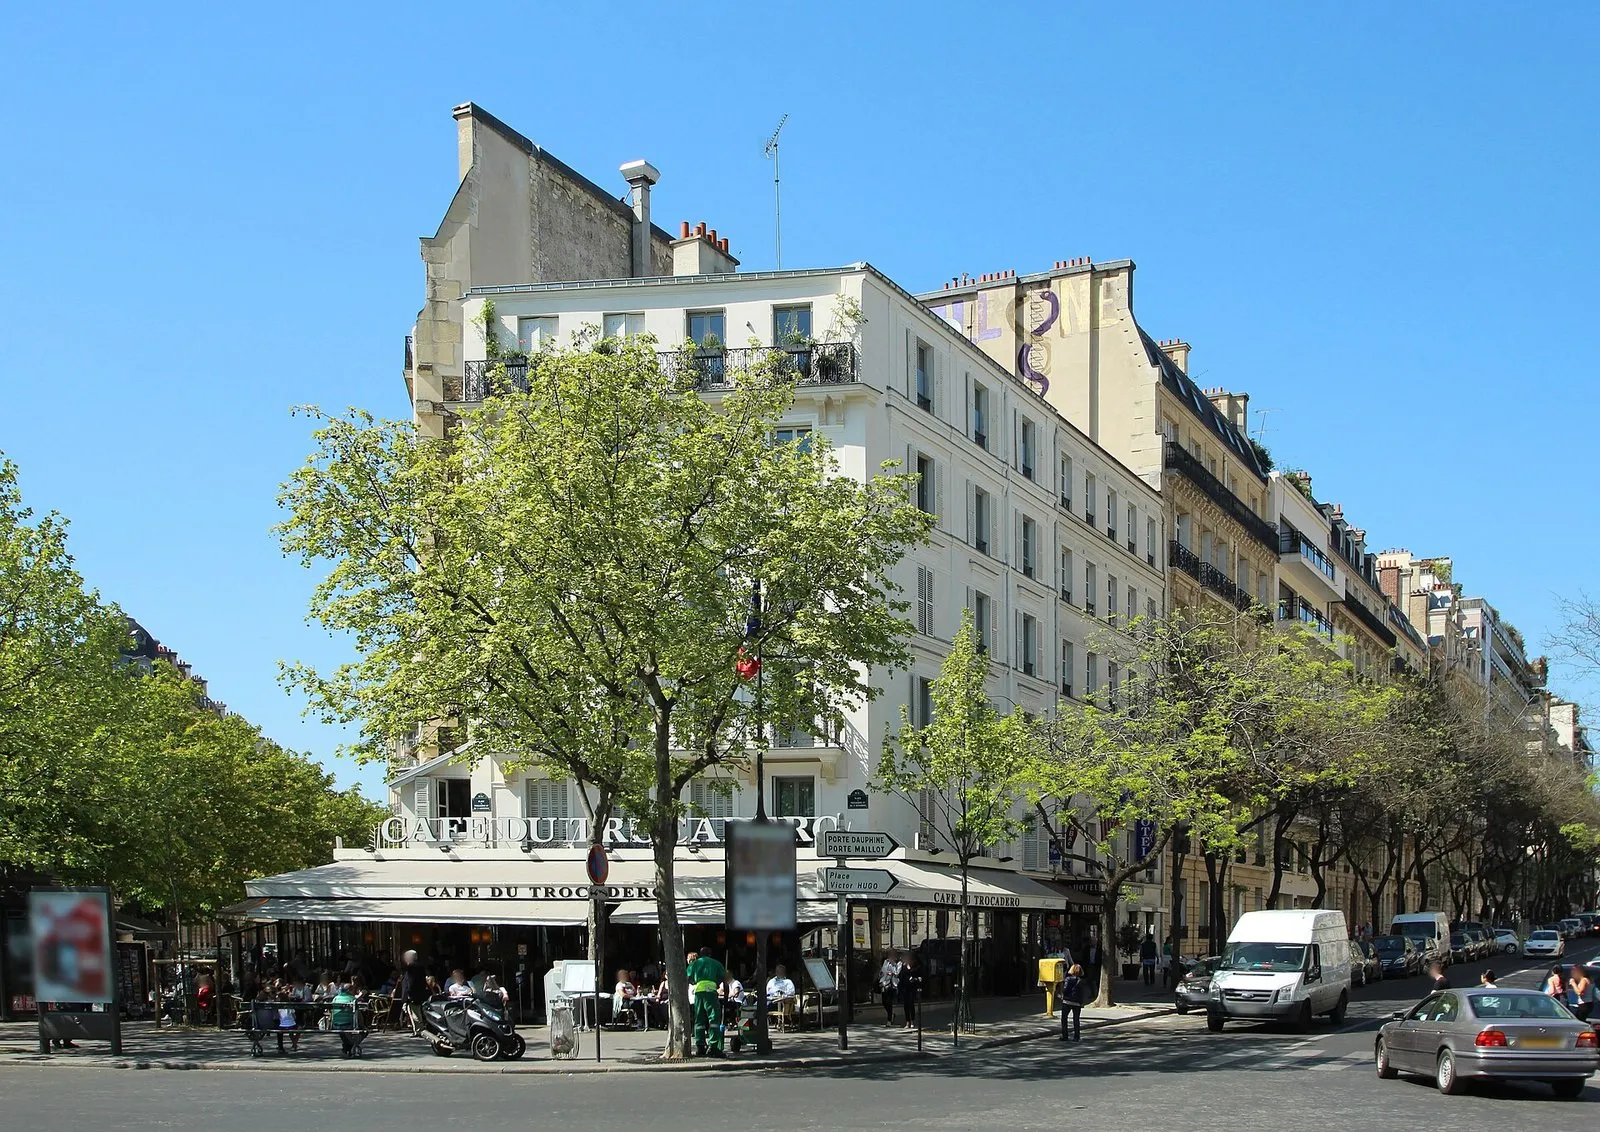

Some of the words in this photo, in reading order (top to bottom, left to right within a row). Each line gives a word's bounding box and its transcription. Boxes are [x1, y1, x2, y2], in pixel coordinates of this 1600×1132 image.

[381, 816, 488, 843] CAFE
[502, 816, 559, 843] DU
[1140, 811, 1151, 857] OTEL
[852, 836, 885, 844] DAUPHINE
[424, 886, 479, 898] CAFE
[490, 886, 518, 898] DU
[529, 886, 658, 898] TROCDER
[857, 882, 878, 890] HUGO
[933, 892, 957, 904] CAFE
[974, 895, 1020, 907] TROCADERO
